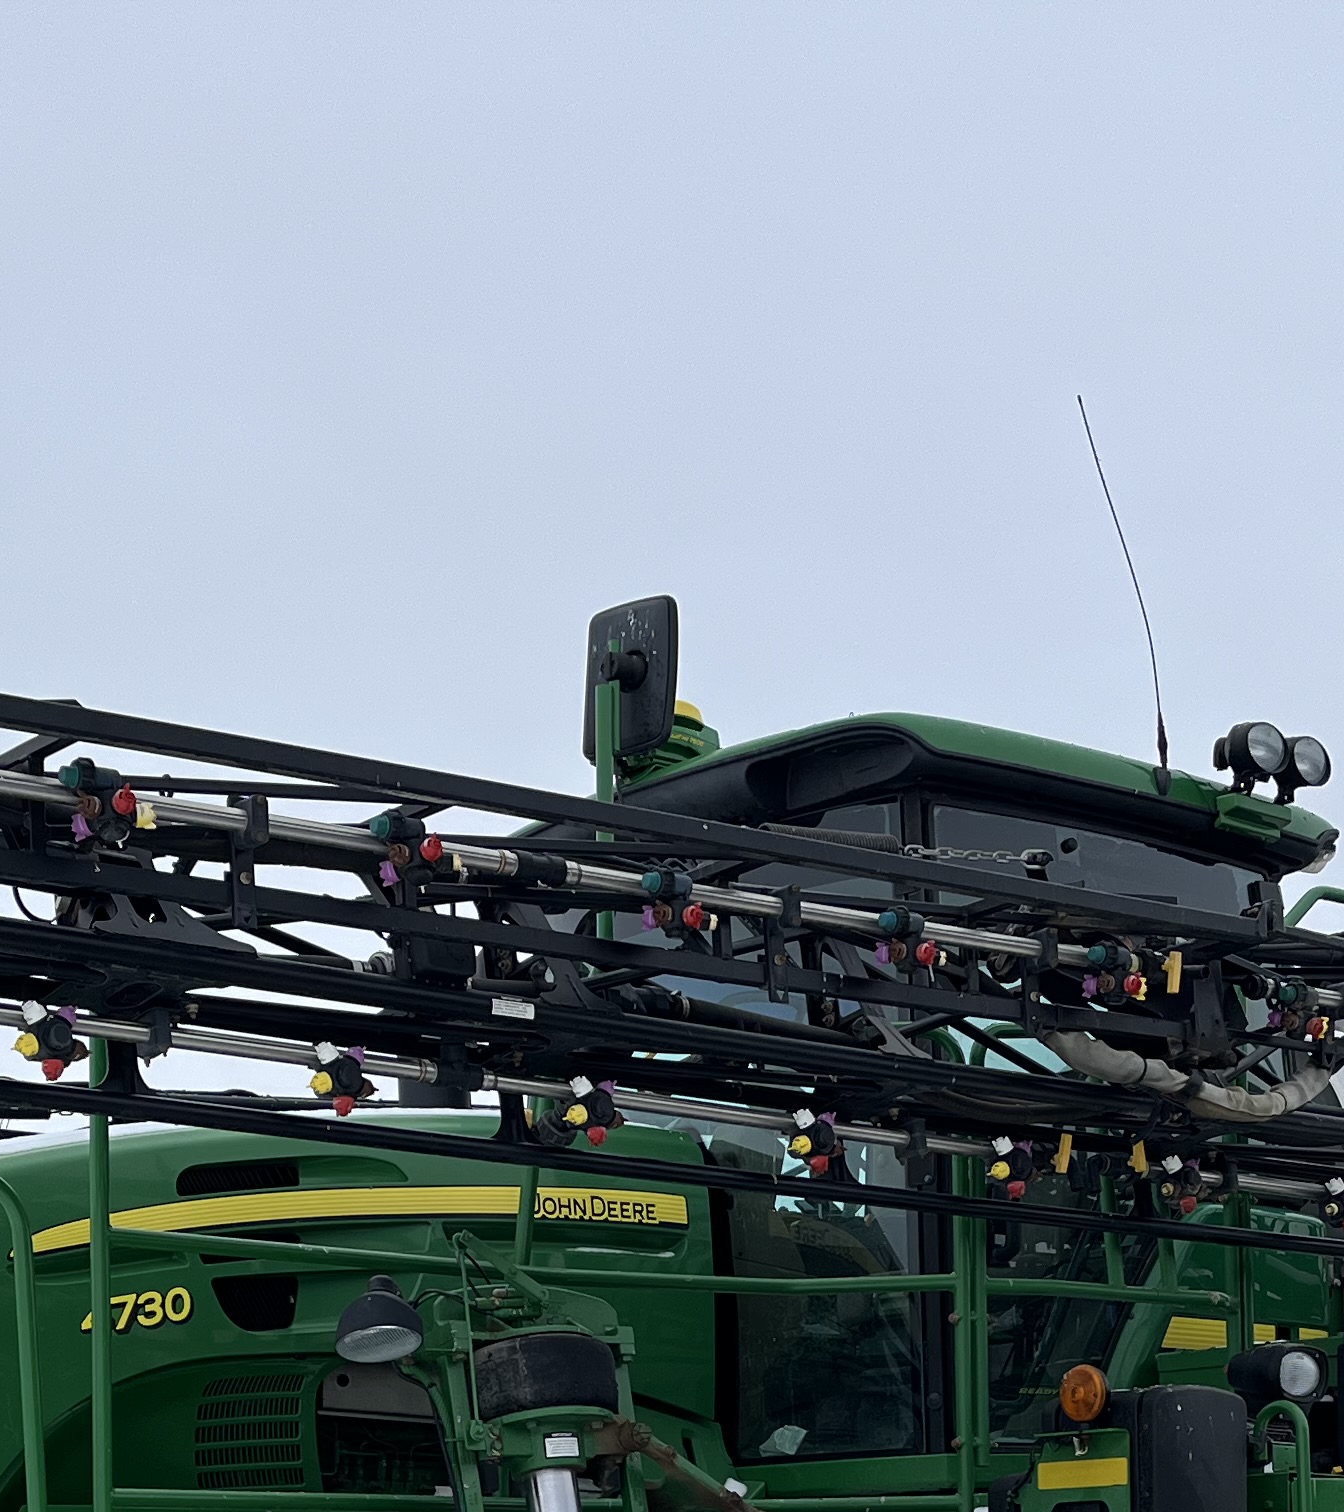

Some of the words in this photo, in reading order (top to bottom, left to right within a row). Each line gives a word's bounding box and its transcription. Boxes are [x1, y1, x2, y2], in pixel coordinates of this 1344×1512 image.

[535, 1193, 587, 1217] JOHN
[590, 1195, 657, 1221] DEERE
[80, 1286, 193, 1332] 730
